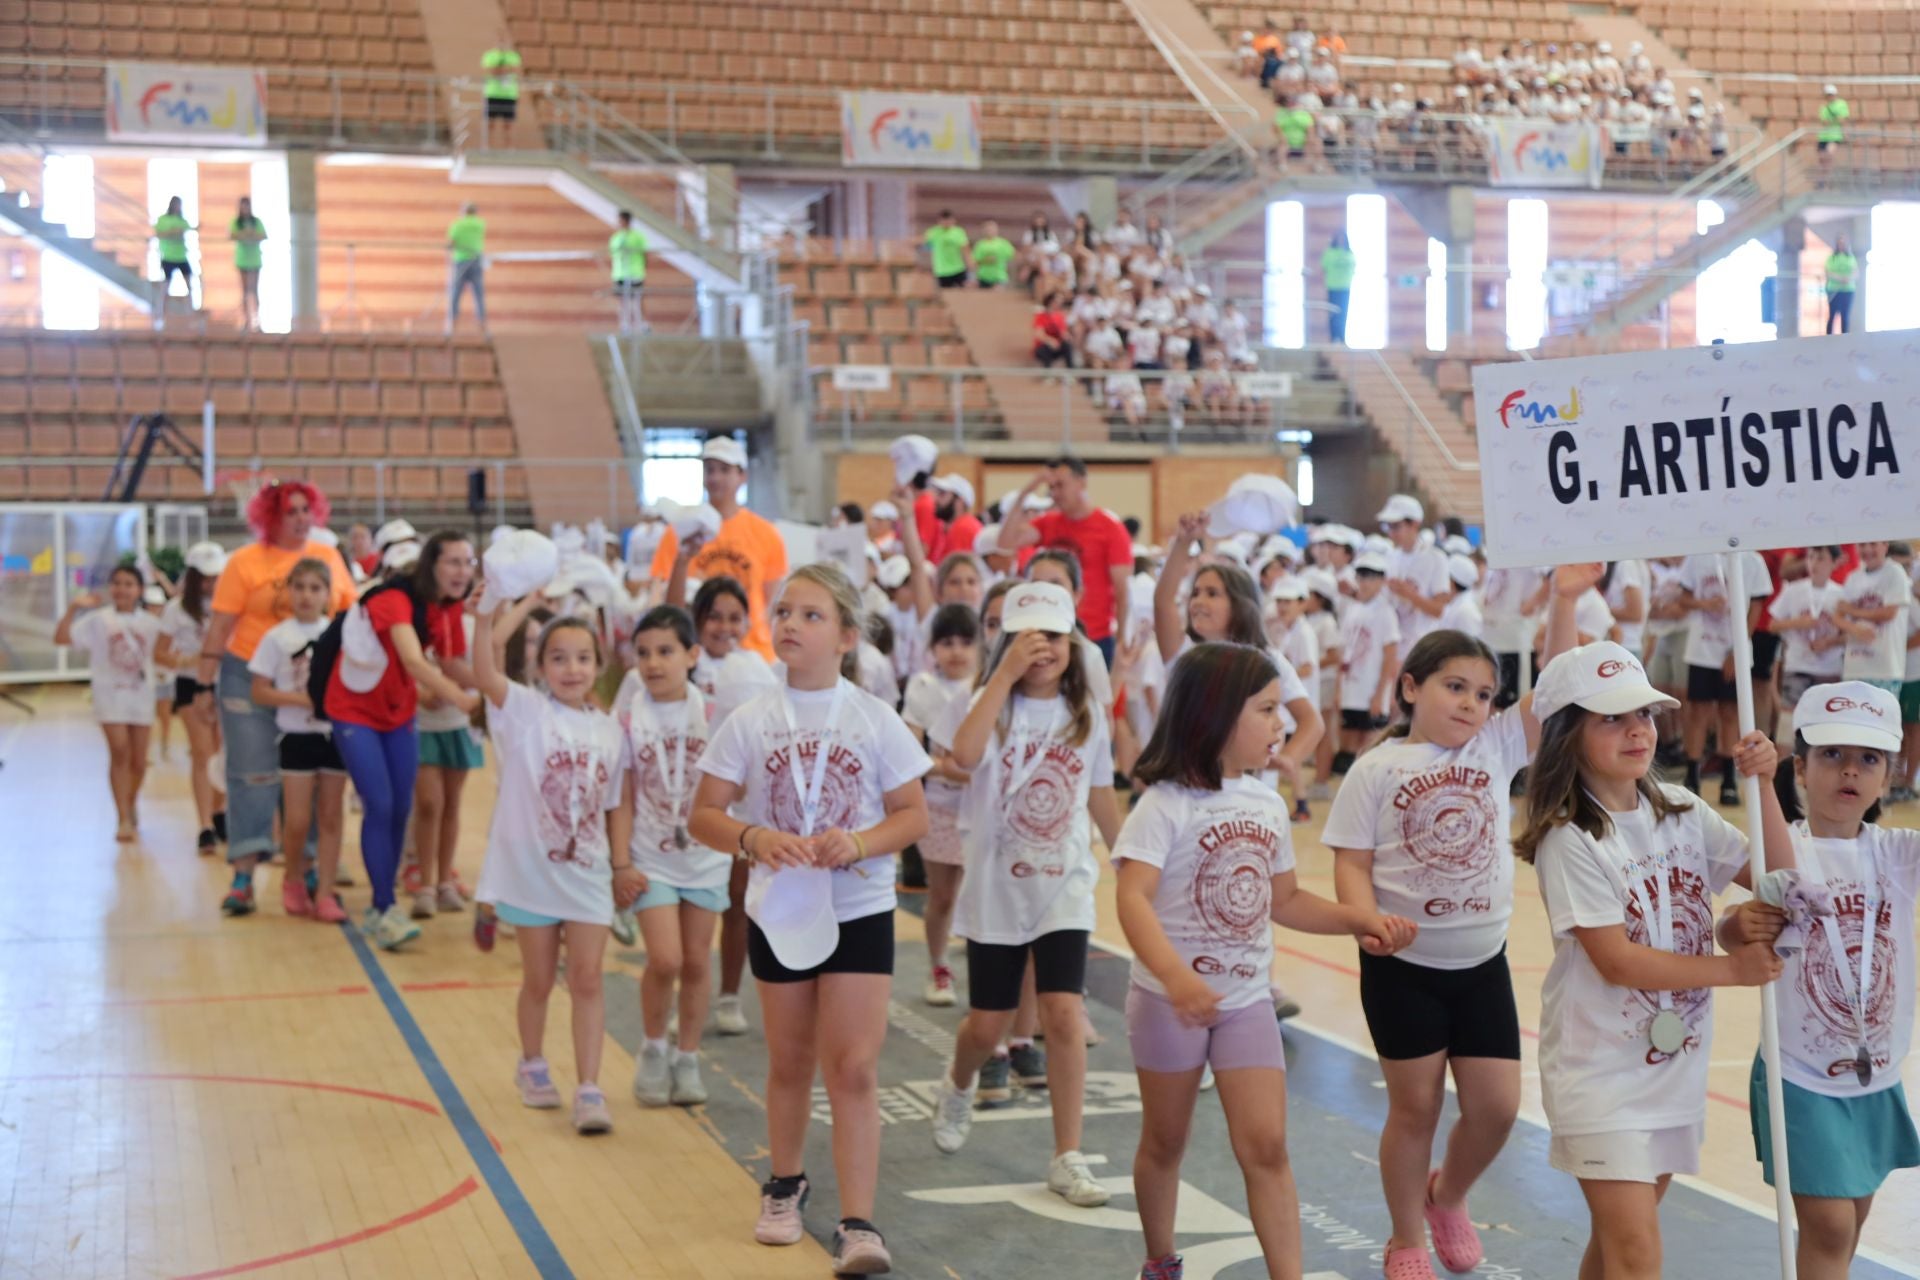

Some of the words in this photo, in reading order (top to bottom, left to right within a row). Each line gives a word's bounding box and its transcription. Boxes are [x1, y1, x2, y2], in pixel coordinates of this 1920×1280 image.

[1548, 429, 1599, 505] G.
[1619, 396, 1901, 498] ARTÍSTICA
[1394, 765, 1490, 811] clausura
